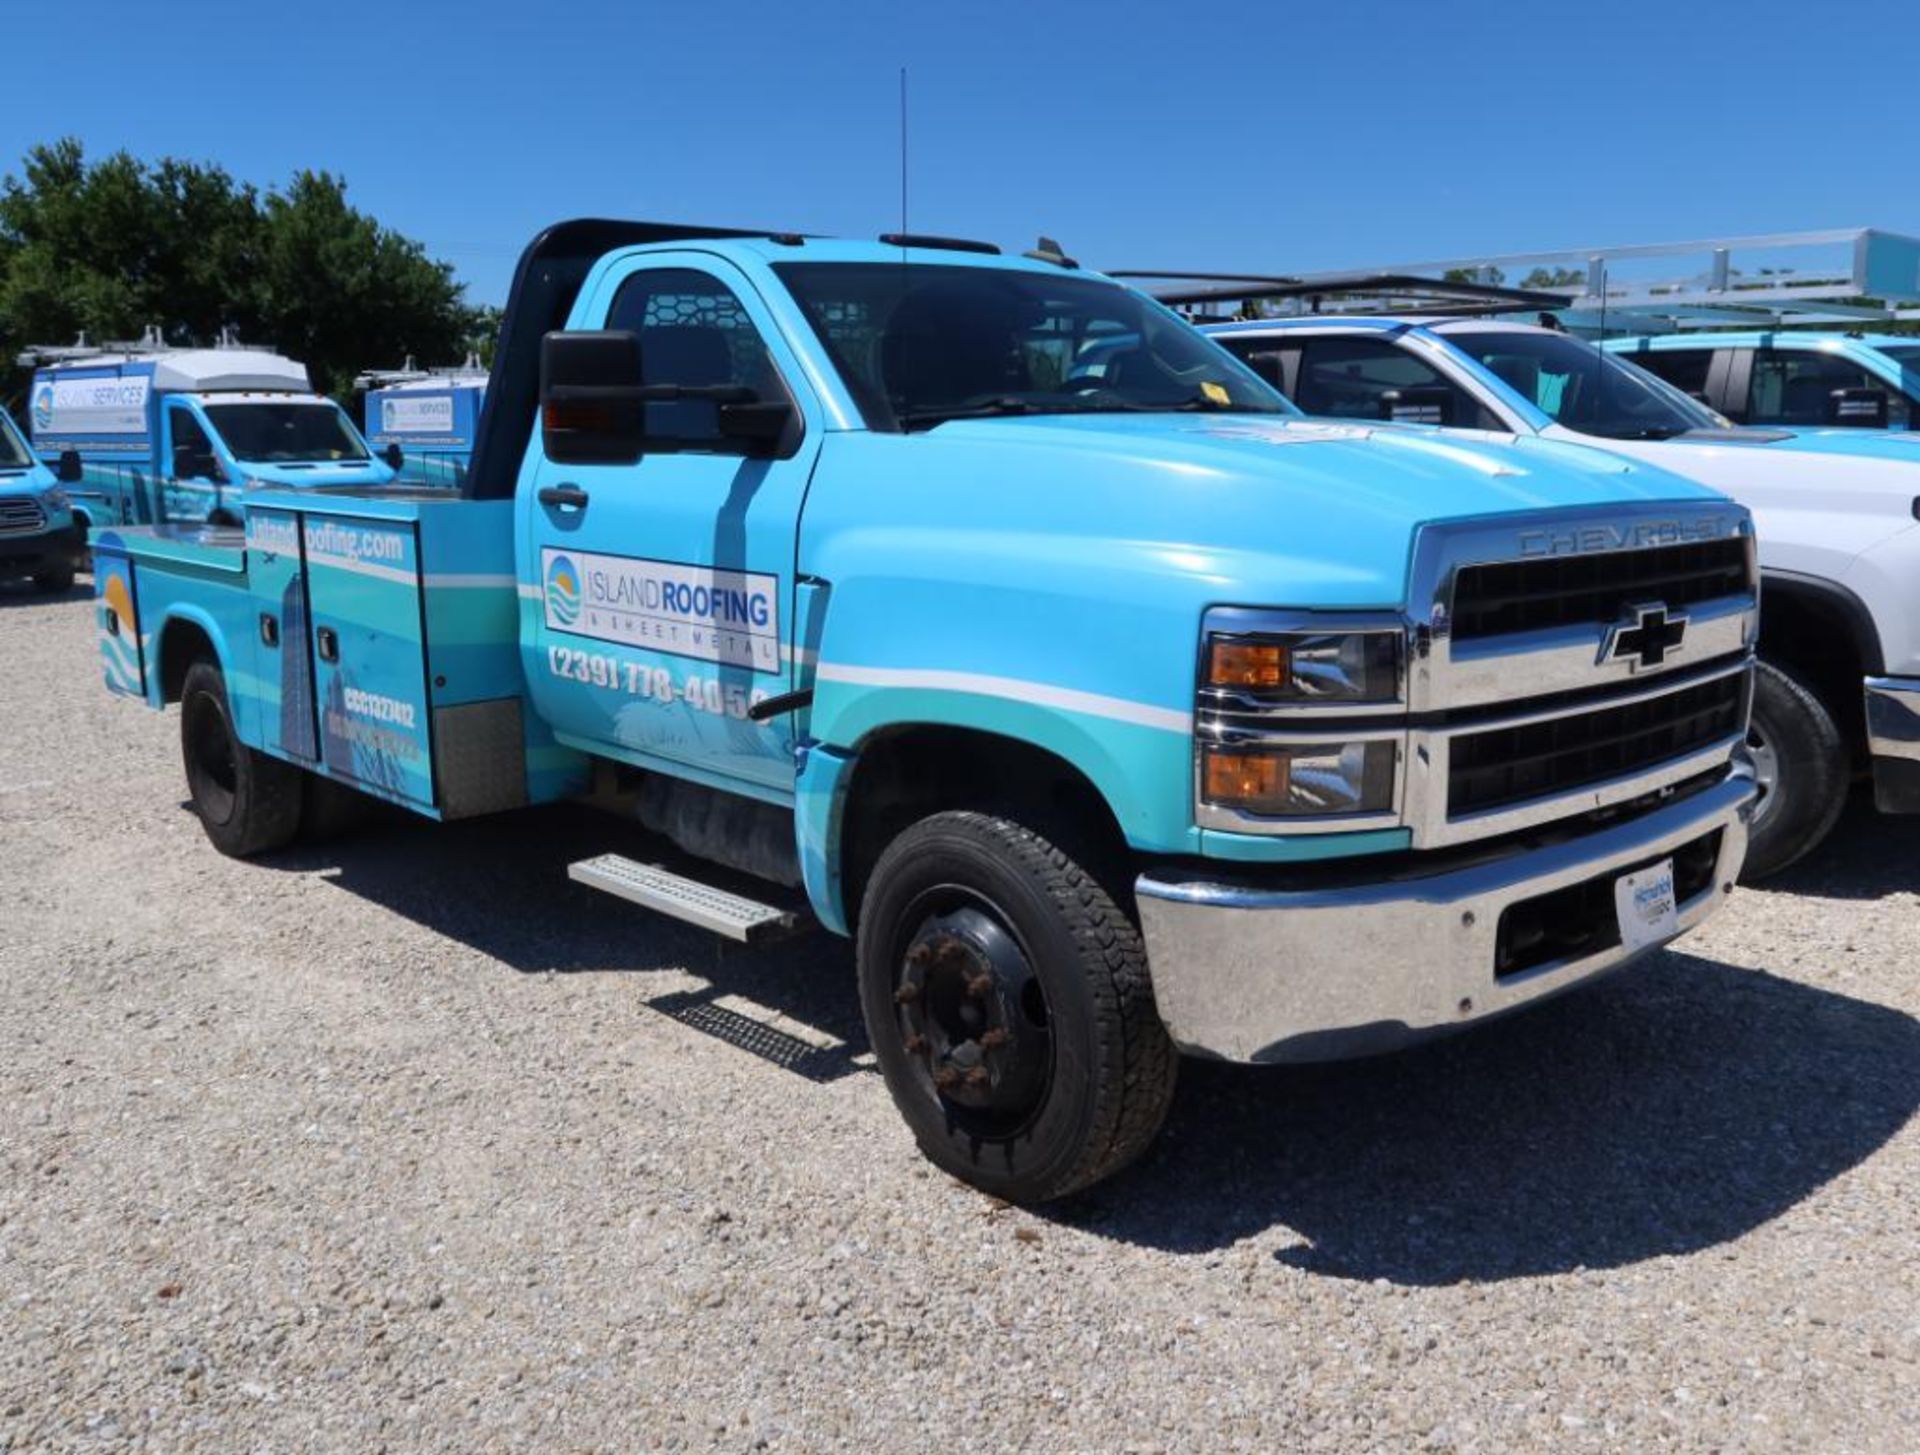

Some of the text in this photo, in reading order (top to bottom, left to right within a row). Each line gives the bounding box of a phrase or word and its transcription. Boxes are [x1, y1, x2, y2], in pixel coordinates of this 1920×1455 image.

[1519, 516, 1725, 556] CHEVROLET
[612, 616, 679, 638] SHEET
[693, 630, 771, 659] METAL
[549, 645, 620, 690] (239)
